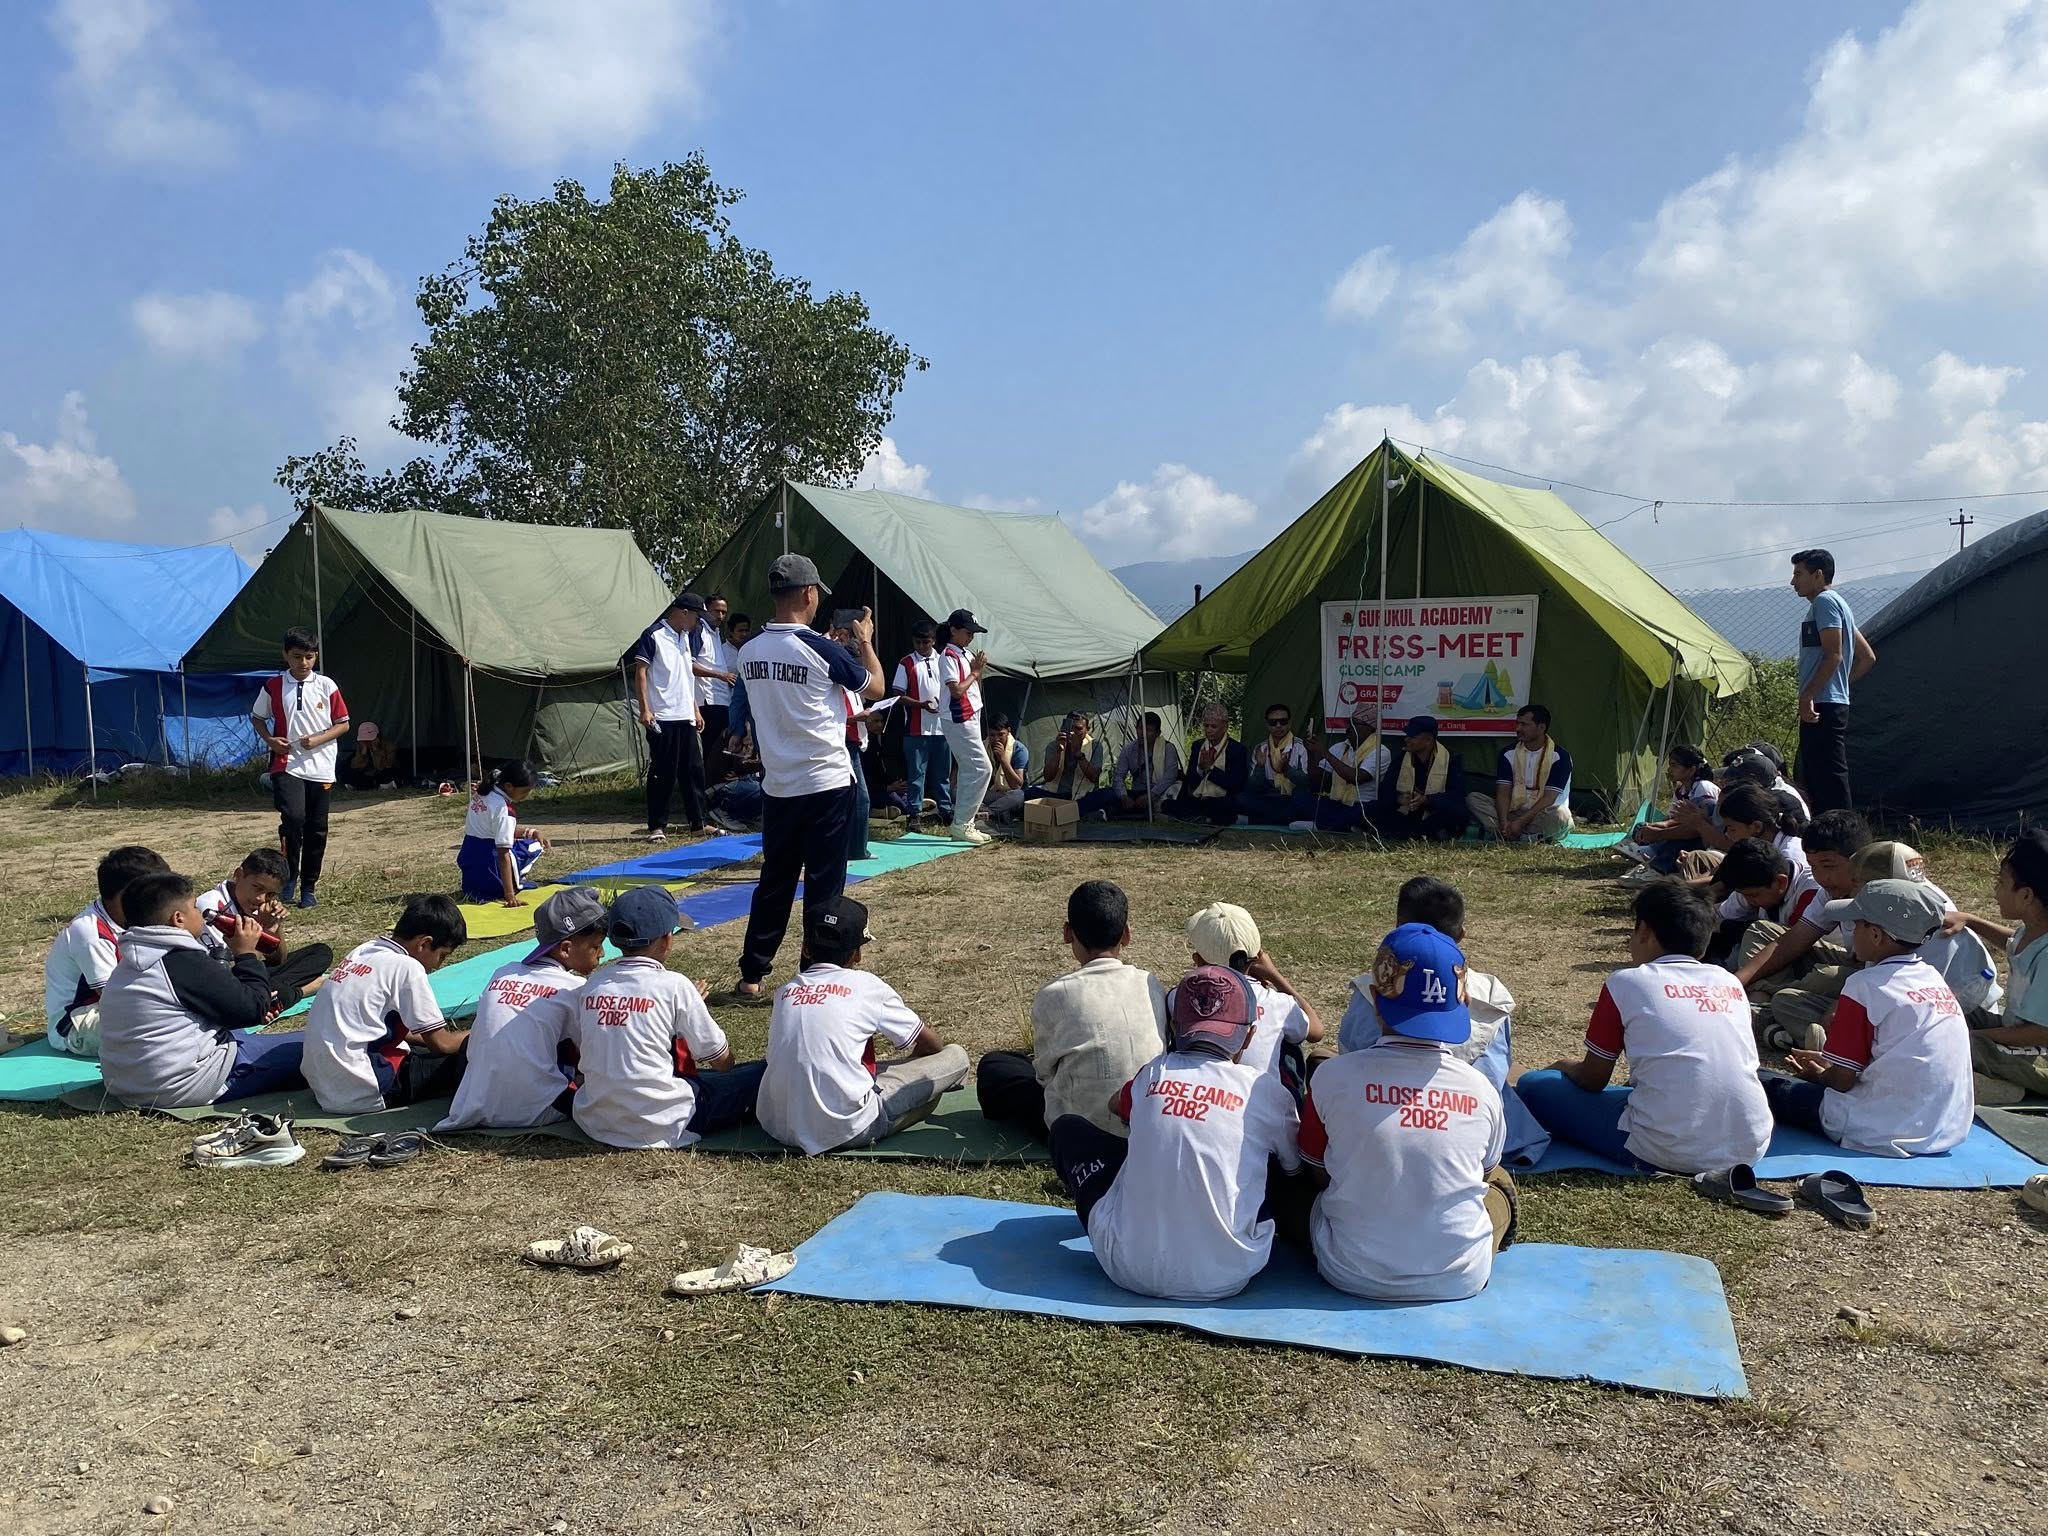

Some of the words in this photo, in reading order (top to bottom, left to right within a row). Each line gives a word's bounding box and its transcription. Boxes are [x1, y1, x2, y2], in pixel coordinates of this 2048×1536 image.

[1420, 606, 1493, 627] ACADEMY
[1338, 632, 1524, 659] PRESS-MEET
[743, 661, 770, 681] LEADER
[772, 662, 808, 685] TEACHER
[1339, 664, 1380, 677] CLOSE
[1383, 664, 1426, 677] CAMP
[1360, 690, 1389, 699] GRAE
[488, 979, 523, 992] CLOSE
[521, 982, 559, 999] CAMP
[781, 984, 815, 1001] CLOSE
[815, 984, 852, 998] CAMP
[1421, 968, 1447, 1003] LA
[1664, 984, 1711, 999] CLOSE
[497, 991, 531, 1009] 2082
[585, 995, 619, 1011] CLOSE
[617, 996, 655, 1014] CAMP
[792, 993, 827, 1007] 2082
[597, 1010, 629, 1027] 2082
[1145, 1080, 1192, 1098] CLOSE
[1192, 1085, 1244, 1112] CAMP
[1365, 1083, 1424, 1107] CLOSE
[1427, 1089, 1478, 1116] CAMP
[1161, 1097, 1209, 1122] 2082
[1399, 1107, 1448, 1131] 2082
